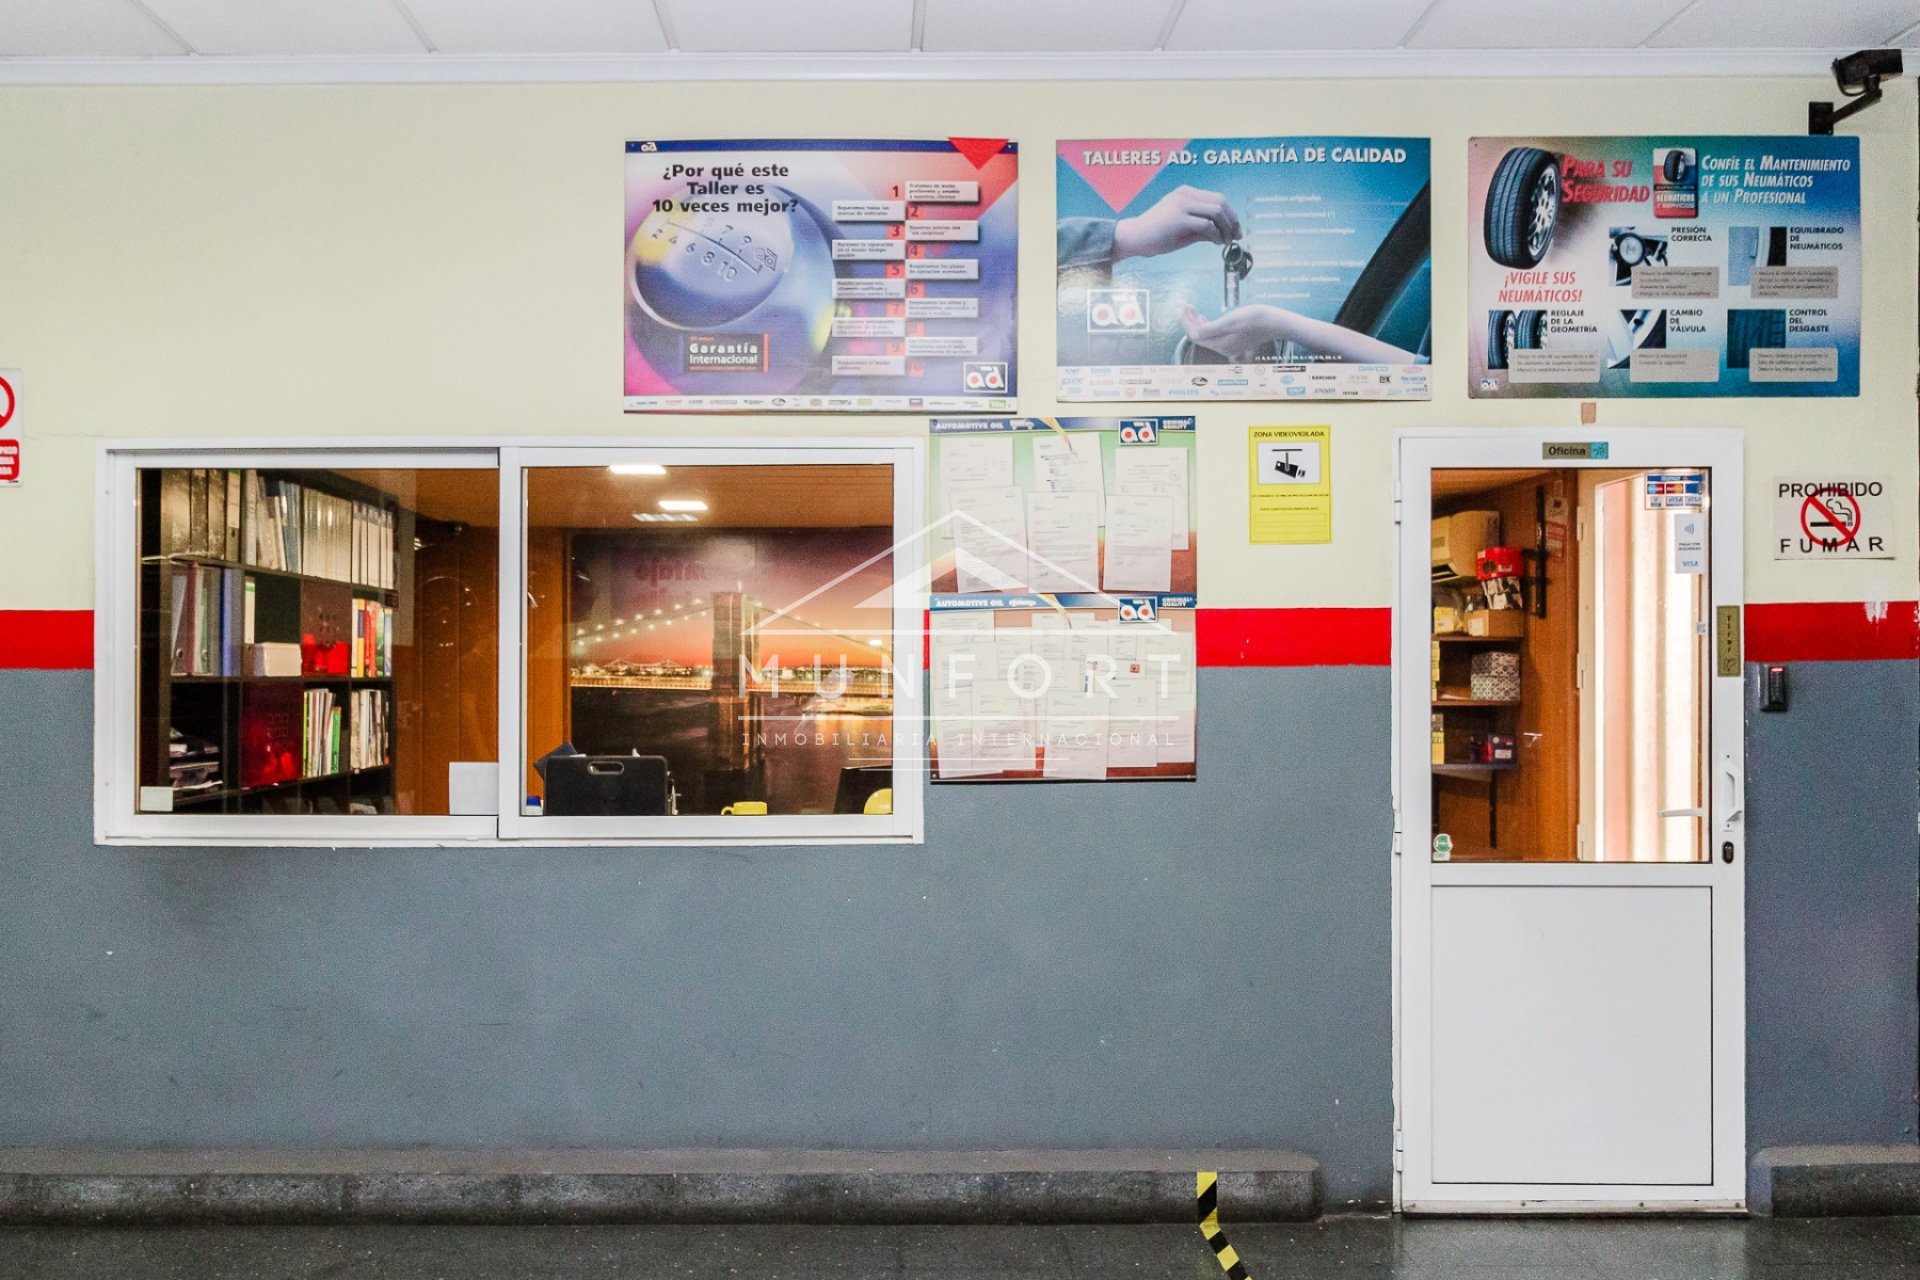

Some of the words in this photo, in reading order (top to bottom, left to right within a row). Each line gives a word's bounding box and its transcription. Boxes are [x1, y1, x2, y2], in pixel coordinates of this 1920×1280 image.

[1083, 150, 1161, 166] TALLERES
[1166, 149, 1198, 165] AD:
[1204, 145, 1298, 165] GARANTÍA
[1304, 147, 1326, 163] DE
[1330, 146, 1407, 164] CALIDAD
[663, 164, 704, 180] ¿Por
[711, 163, 744, 180] qué
[752, 164, 789, 177] este
[687, 181, 738, 195] Taller
[745, 184, 765, 195] es
[892, 185, 899, 197] 1
[652, 199, 673, 212] 10
[680, 200, 729, 212] veces
[737, 199, 799, 216] mejor?
[910, 206, 919, 218] 2
[892, 226, 900, 237] 3
[1671, 225, 1706, 234] PRESIÓN
[1790, 226, 1844, 234] EQUILIBRADO
[1671, 234, 1712, 242] CORRECTA
[910, 244, 918, 256] 4
[1790, 242, 1843, 250] NEUMÁTICOS
[892, 263, 900, 275] 5
[1504, 271, 1549, 288] ¡VIGILE
[1553, 271, 1576, 285] SUS
[910, 284, 918, 295] 6
[1498, 286, 1583, 303] NEUMÁTICOS!
[1670, 309, 1703, 317] CAMBIO
[1789, 309, 1827, 317] CONTROL
[1670, 317, 1680, 325] DE
[1789, 317, 1803, 325] DEL
[1550, 325, 1598, 333] GEOMETRÍA
[1789, 325, 1829, 333] DESGASTE
[689, 342, 758, 354] Garantía
[689, 354, 758, 364] Internacional
[936, 421, 988, 430] AUTOMOTIVE
[1548, 446, 1586, 456] Oficina
[1779, 482, 1883, 498] PROHIBIDO
[1780, 536, 1884, 553] FUMAR
